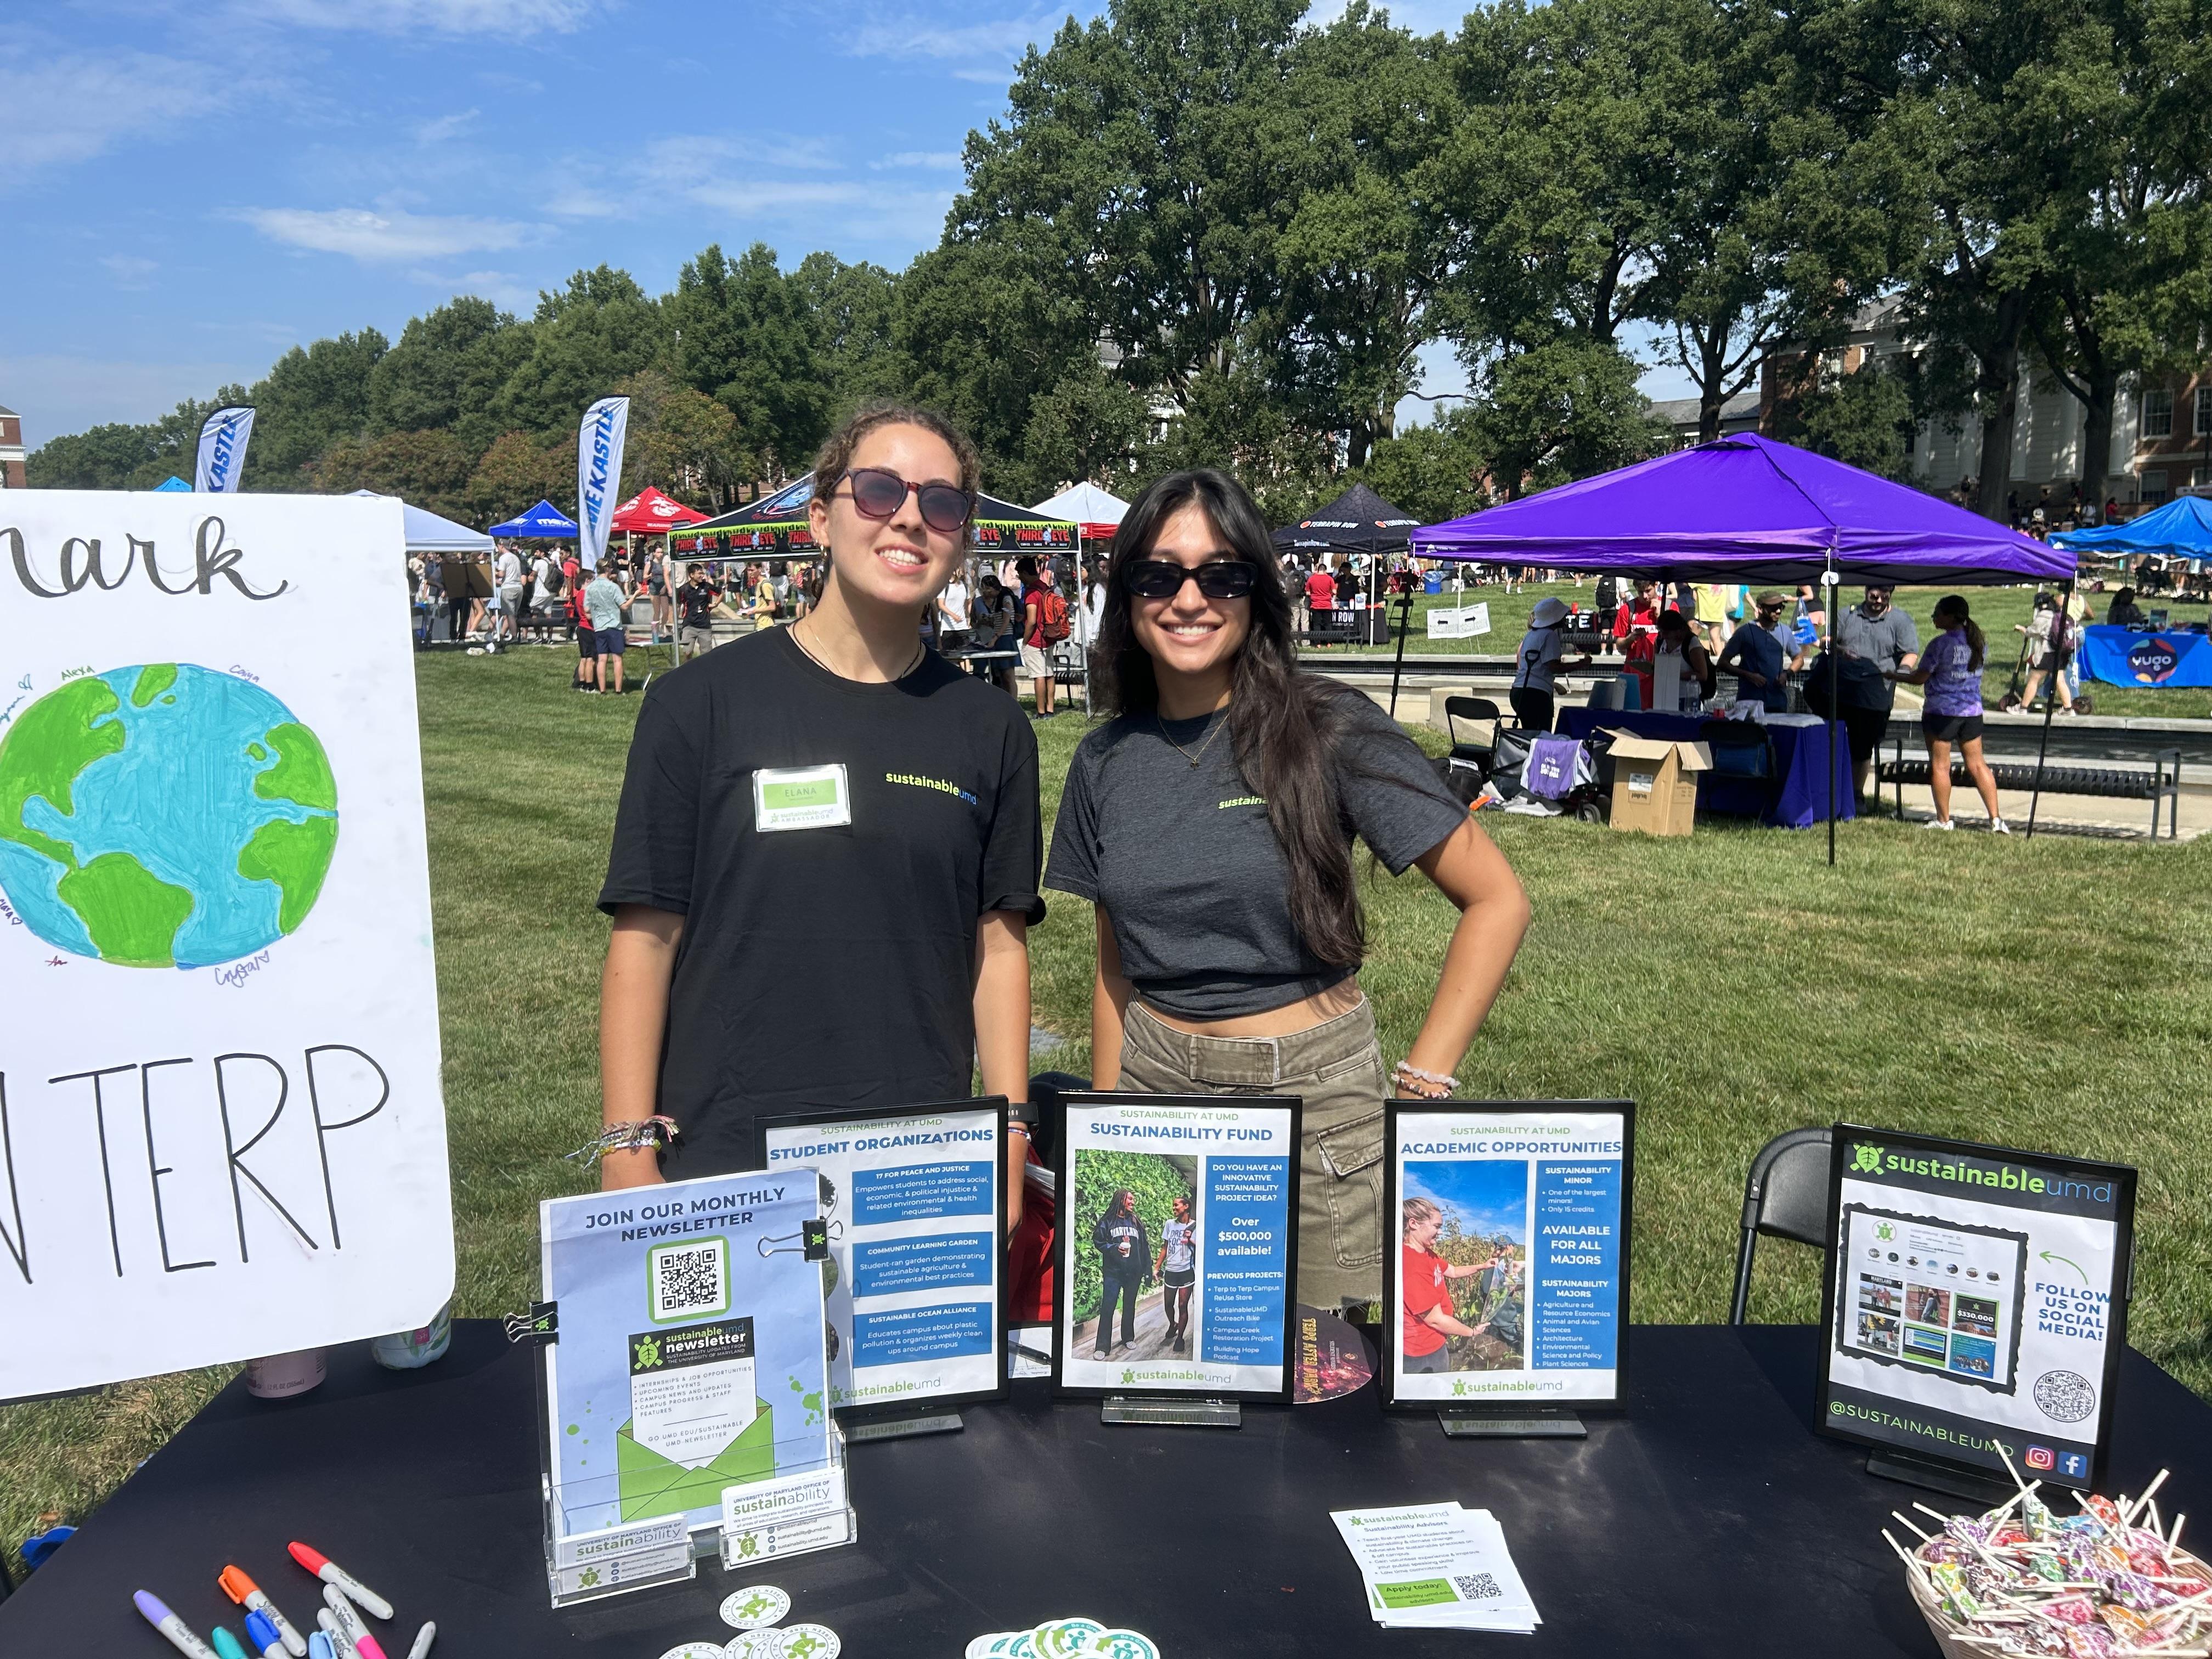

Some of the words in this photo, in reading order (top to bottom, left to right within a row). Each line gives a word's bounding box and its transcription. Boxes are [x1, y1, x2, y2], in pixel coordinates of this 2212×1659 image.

[730, 534, 752, 546] THIRD
[759, 532, 776, 545] EYE
[981, 529, 1001, 541] EYE
[1016, 529, 1043, 541] THIRD
[1052, 529, 1070, 541] EYE
[675, 539, 696, 551] THIRD
[703, 537, 718, 549] EYE
[1338, 612, 1355, 623] ROW
[61, 665, 95, 681] Alexa
[785, 787, 817, 797] ELANA
[885, 772, 977, 805] sustainableumd
[781, 808, 833, 818] sustainableumd
[781, 814, 830, 822] AMBASSADOR
[215, 956, 260, 988] Crystal
[1120, 1110, 1198, 1119] SUSTAINABILITY
[821, 1120, 901, 1135] SUSTAINABILITY
[1091, 1123, 1222, 1139] SUSTAINABILITY
[1227, 1129, 1272, 1140] FUND
[770, 1141, 849, 1160] STUDENT
[855, 1130, 992, 1150] ORGANIZATIONS
[1401, 1142, 1486, 1153] ACADEMIC
[1492, 1142, 1620, 1153] OPPORTUNITIES
[48, 1044, 390, 1277] TERP
[1887, 1155, 2110, 1201] sustainableumd
[855, 1184, 894, 1193] Empowers
[586, 1210, 633, 1228] JOIN
[641, 1203, 683, 1220] OUR
[691, 1187, 784, 1212] MONTHLY
[622, 1212, 752, 1241] NEWSLETTER
[1232, 1217, 1259, 1226] Over
[1218, 1231, 1271, 1242] $500,000
[1543, 1226, 1610, 1235] AVAILABLE
[867, 1245, 910, 1254] COMMUNITY
[912, 1241, 947, 1249] LEARNING
[1218, 1246, 1271, 1255] available!
[1551, 1240, 1576, 1249] FOR
[1578, 1241, 1601, 1250] ALL
[860, 1260, 903, 1269] Student-ran
[905, 1257, 931, 1266] garden
[932, 1253, 985, 1261] demonstrating
[1551, 1255, 1600, 1264] MAJORS
[879, 1267, 919, 1277] sustainable
[921, 1264, 960, 1273] agriculture
[871, 1275, 923, 1287] environmental
[942, 1272, 974, 1280] practices
[2034, 1283, 2111, 1304] FOLLOW
[2045, 1297, 2067, 1309] US
[2074, 1302, 2100, 1314] ON
[869, 1313, 916, 1323] SUSTAINABLE
[2039, 1309, 2104, 1328] SOCIAL
[666, 1323, 743, 1342] sustainableumd
[2039, 1322, 2102, 1341] MEDIA!
[666, 1333, 745, 1353] newsletter
[1137, 1370, 1231, 1383] sustainableumd
[844, 1378, 940, 1398] sustainableumd
[1468, 1380, 1562, 1392] sustainableumd
[733, 1493, 764, 1503] UNIVERSITY
[774, 1486, 802, 1497] MARYLAND
[803, 1482, 821, 1490] OFFICE
[734, 1488, 829, 1515] sustainability
[1364, 1510, 1449, 1522] sustainableumd
[577, 1526, 680, 1555] sustainability
